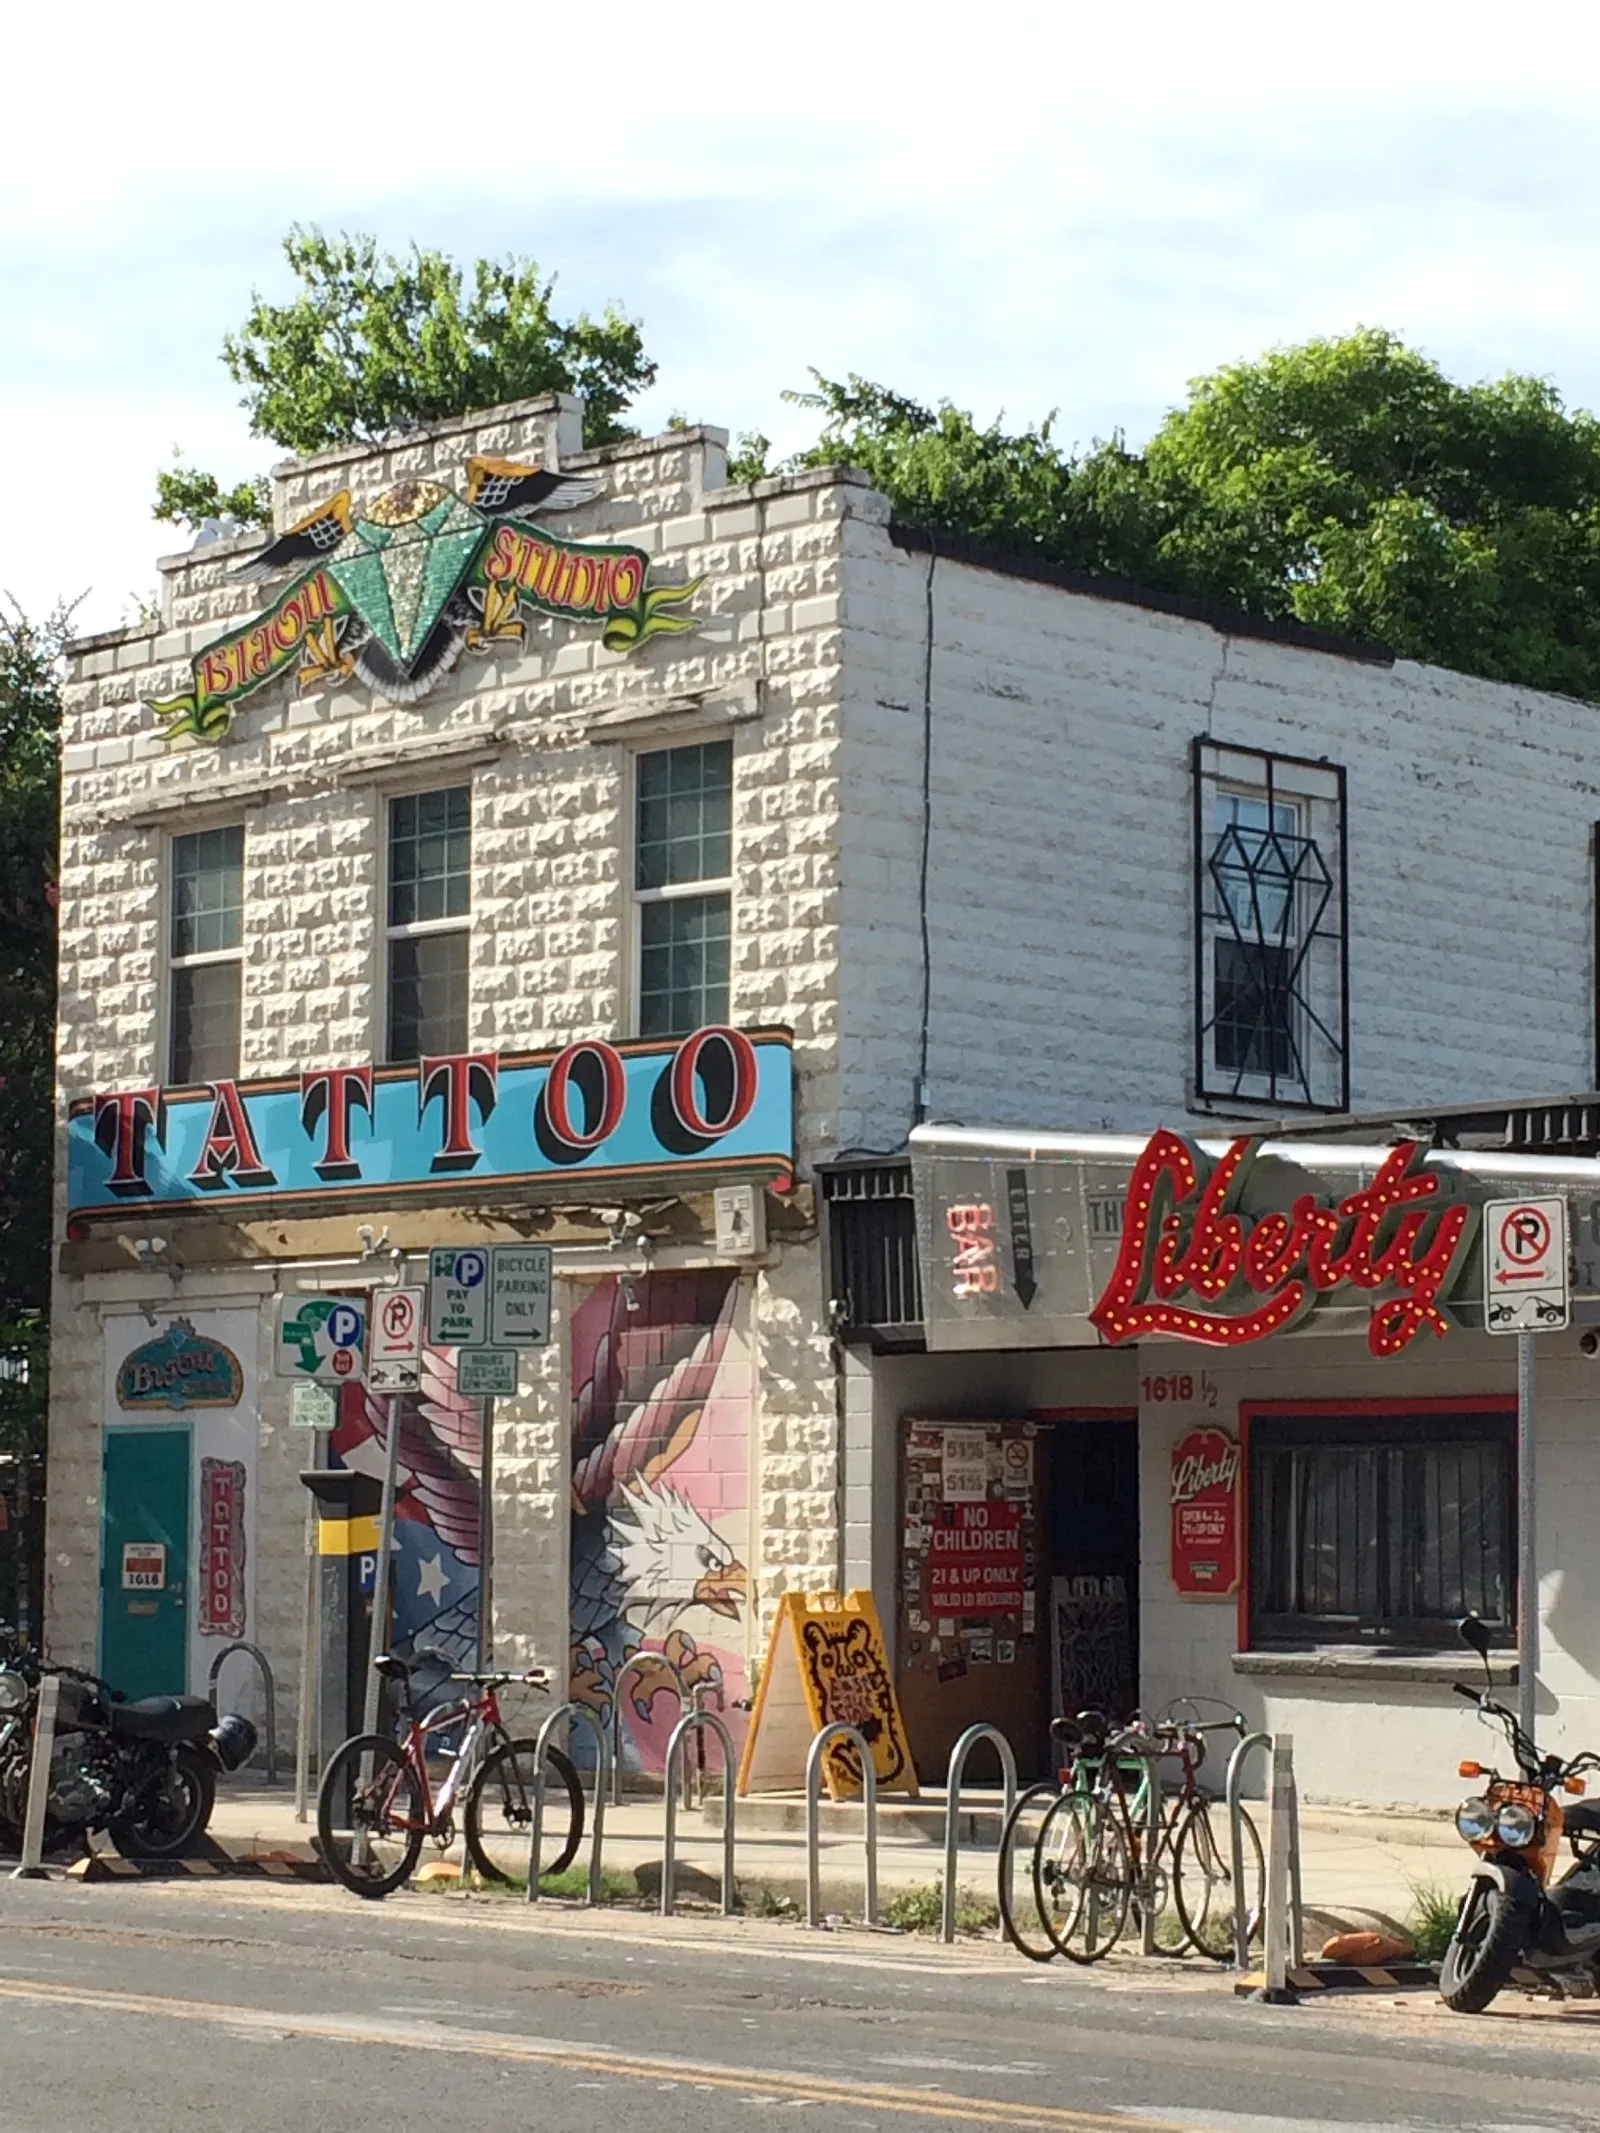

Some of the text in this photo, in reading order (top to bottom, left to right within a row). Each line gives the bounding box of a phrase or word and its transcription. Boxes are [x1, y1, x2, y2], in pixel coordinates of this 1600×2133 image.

[485, 526, 642, 614] STUDIO
[95, 1025, 758, 1196] TATTOO
[1009, 1187, 1031, 1260] ENTER
[1088, 1200, 1126, 1232] TH
[946, 1203, 993, 1298] BAR
[1088, 1122, 1469, 1358] Liberty
[497, 1257, 547, 1272] BICYCLE
[446, 1289, 470, 1300] PAY
[496, 1279, 548, 1294] PARKING
[450, 1303, 466, 1314] TO
[505, 1302, 537, 1317] ONLY
[335, 1310, 356, 1344] P
[441, 1317, 474, 1328] PARK
[1142, 1375, 1194, 1402] 1618
[947, 1474, 984, 1491] 51%
[1171, 1448, 1239, 1504] Liberty
[963, 1507, 989, 1527] NO
[212, 1476, 231, 1614] TATTOO
[933, 1530, 1019, 1551] CHILDREN
[361, 1556, 375, 1583] P
[932, 1567, 1019, 1584] 21 & UP ONLY
